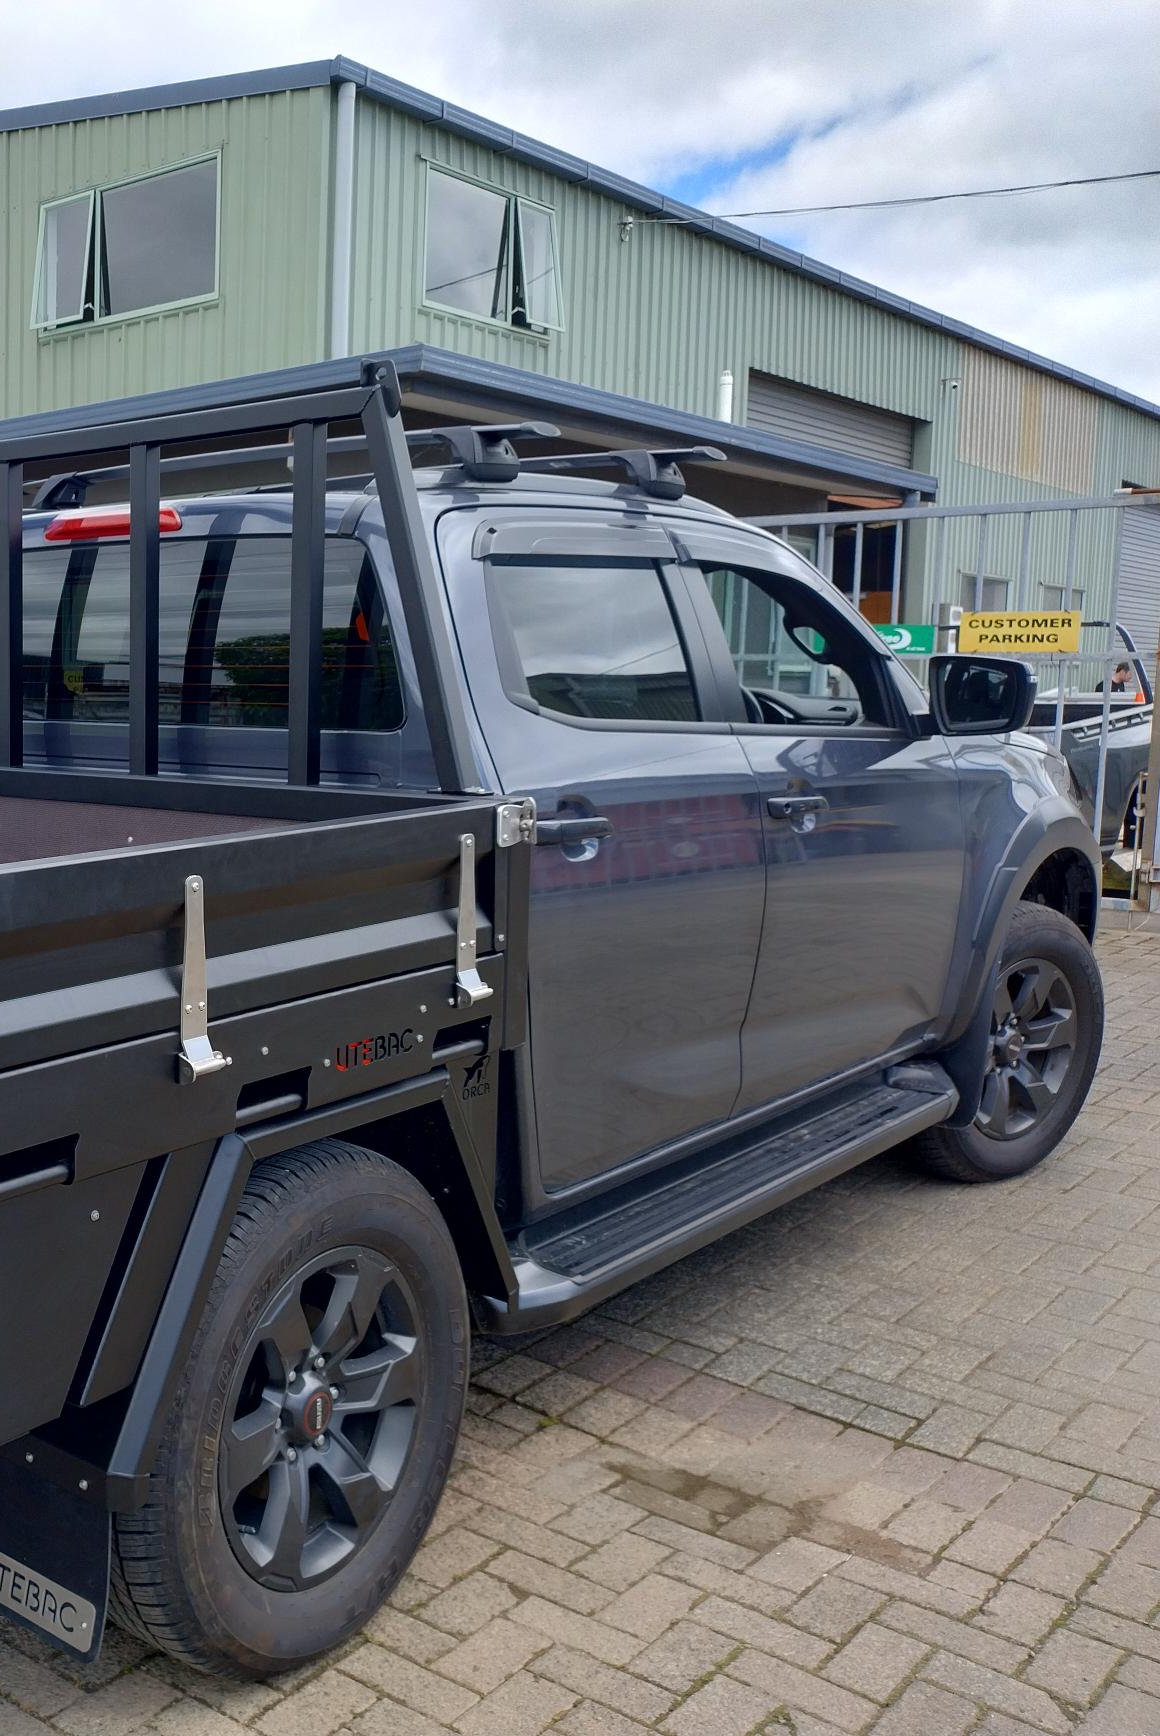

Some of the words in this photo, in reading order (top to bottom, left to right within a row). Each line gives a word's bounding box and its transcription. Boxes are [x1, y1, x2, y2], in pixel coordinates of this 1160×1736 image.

[968, 618, 1072, 629] CUSTOMER
[978, 633, 1059, 644] PARKING
[336, 1028, 414, 1072] UTEBAC
[462, 1081, 490, 1101] ORCA
